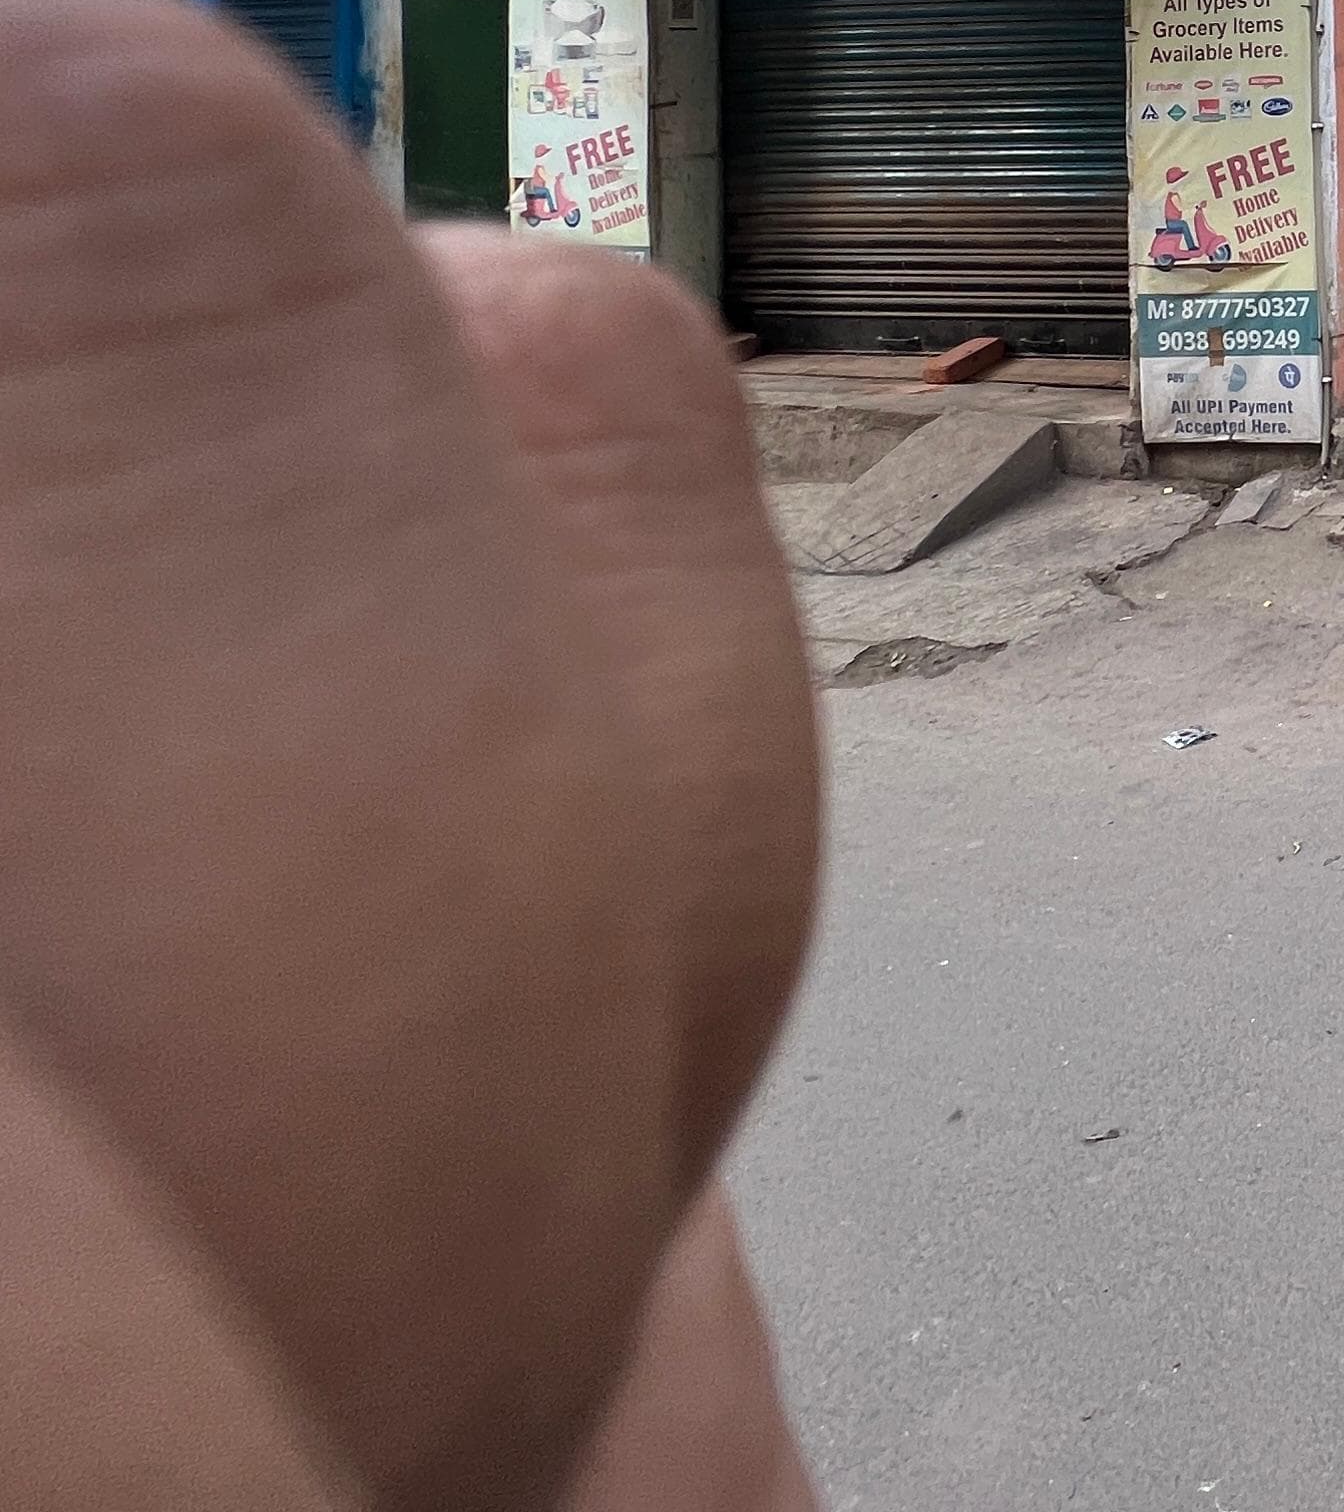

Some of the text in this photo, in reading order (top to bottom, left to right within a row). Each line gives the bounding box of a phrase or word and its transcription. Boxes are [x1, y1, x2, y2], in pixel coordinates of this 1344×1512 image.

[1153, 17, 1284, 40] Grocery Items
[1150, 42, 1288, 63] Available Here.
[566, 124, 635, 175] FREE
[1206, 138, 1295, 199] FREE
[589, 181, 640, 213] Delivery
[1233, 188, 1280, 218] Home
[1234, 207, 1299, 244] Delivery
[1147, 297, 1309, 320] M: 8777750327
[1171, 399, 1294, 416] All UPI Payment
[1174, 419, 1291, 435] Accepted Here.
